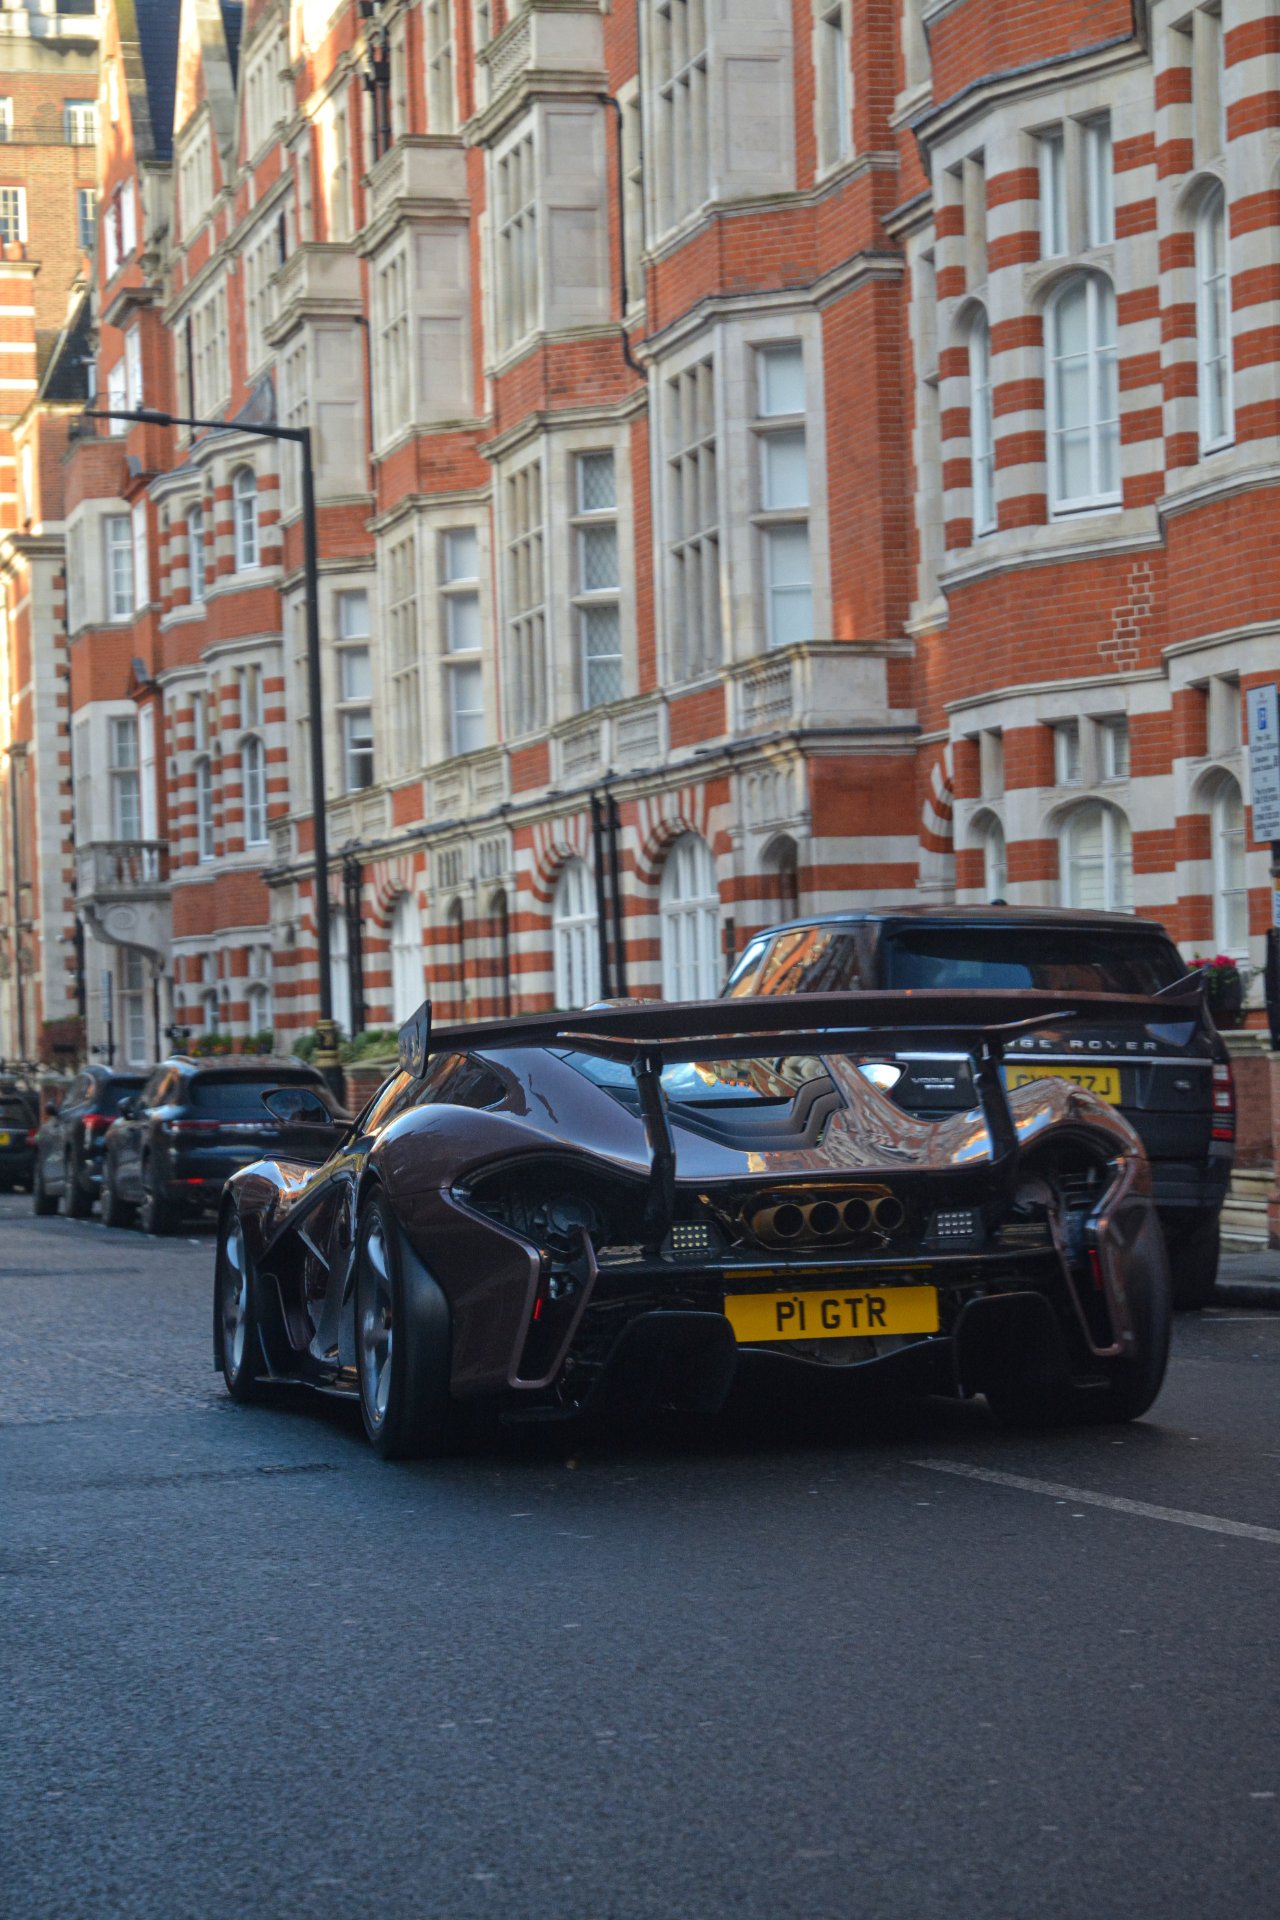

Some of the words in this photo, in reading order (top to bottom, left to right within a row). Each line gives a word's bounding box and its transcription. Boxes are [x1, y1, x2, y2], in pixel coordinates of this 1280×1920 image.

[1069, 1039, 1158, 1050] ROVER
[775, 1300, 806, 1332] P1
[820, 1296, 887, 1330] GTR
